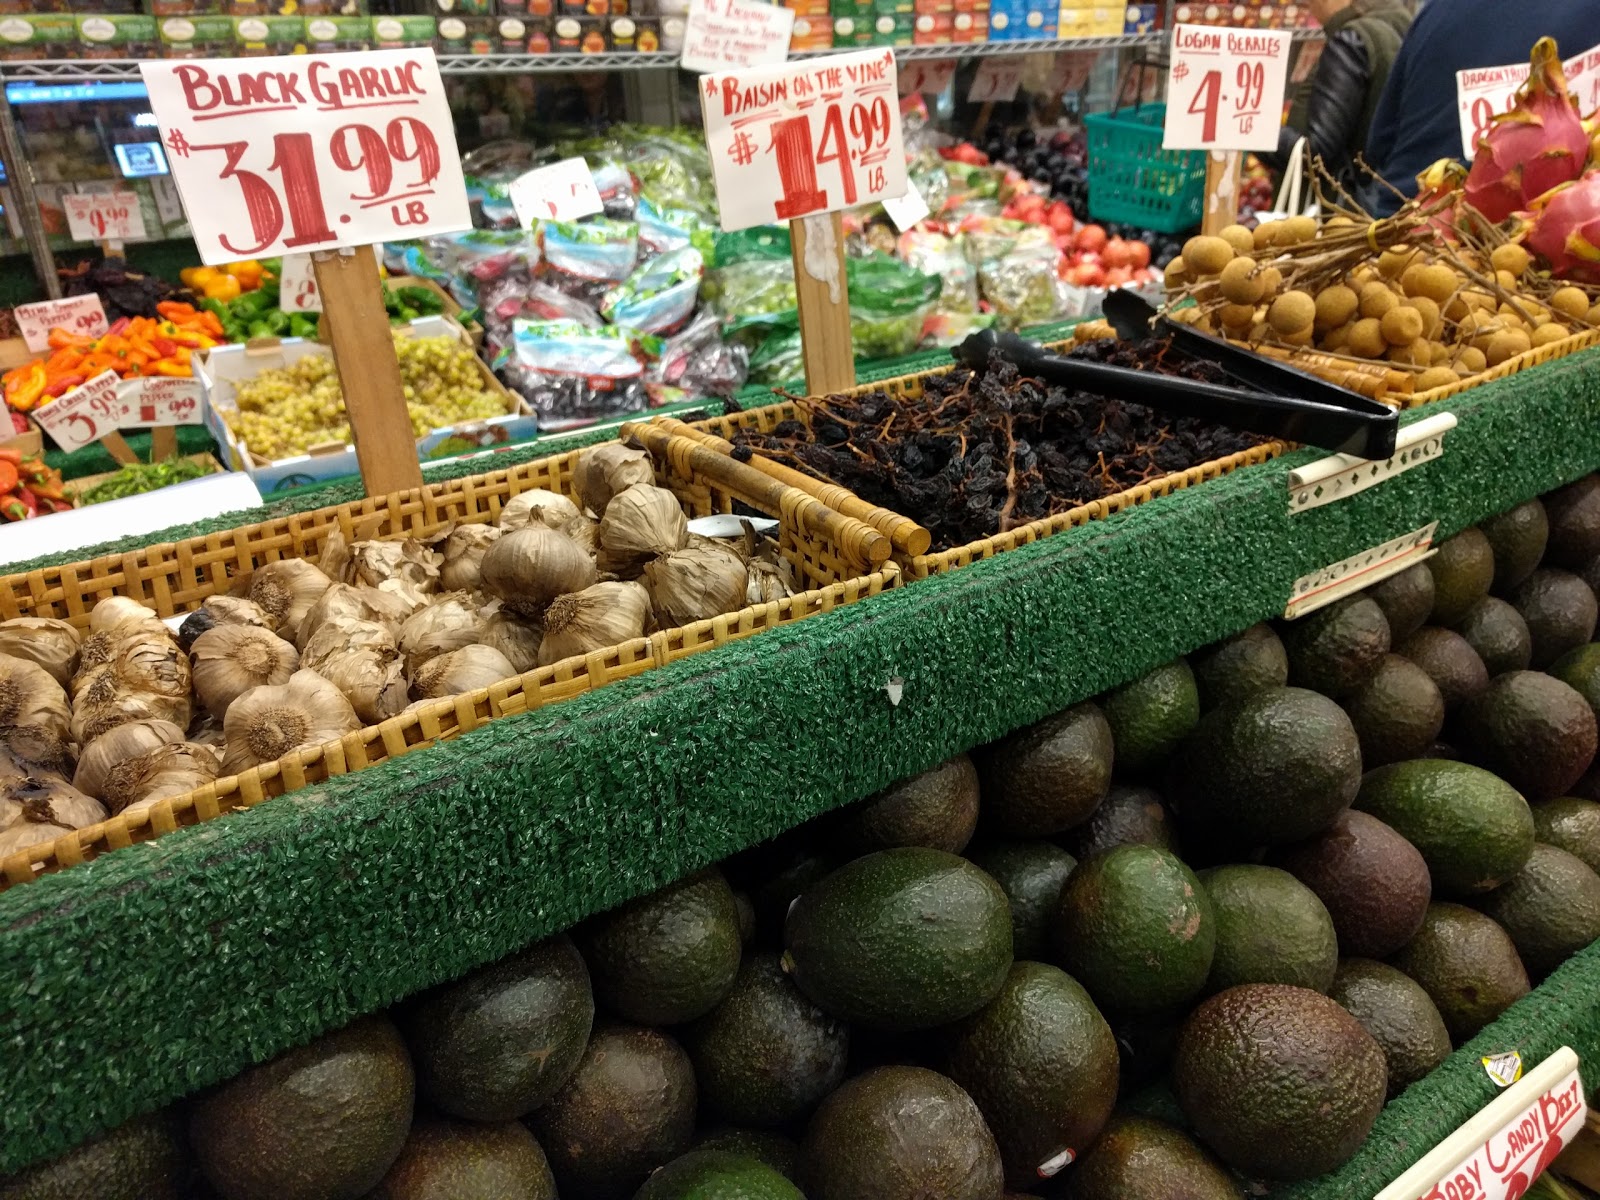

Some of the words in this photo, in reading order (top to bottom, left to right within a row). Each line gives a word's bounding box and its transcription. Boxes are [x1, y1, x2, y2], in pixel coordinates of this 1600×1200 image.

[1175, 26, 1221, 49] LOGAN
[1228, 33, 1280, 55] BERRIES
[173, 65, 306, 111] BLACK
[308, 60, 426, 109] GARLIC
[793, 74, 814, 97] ON
[815, 67, 844, 91] THE
[1462, 69, 1504, 86] DRAGON
[1239, 116, 1253, 134] LB
[392, 200, 429, 226] LB
[1485, 1108, 1541, 1173] CANDY
